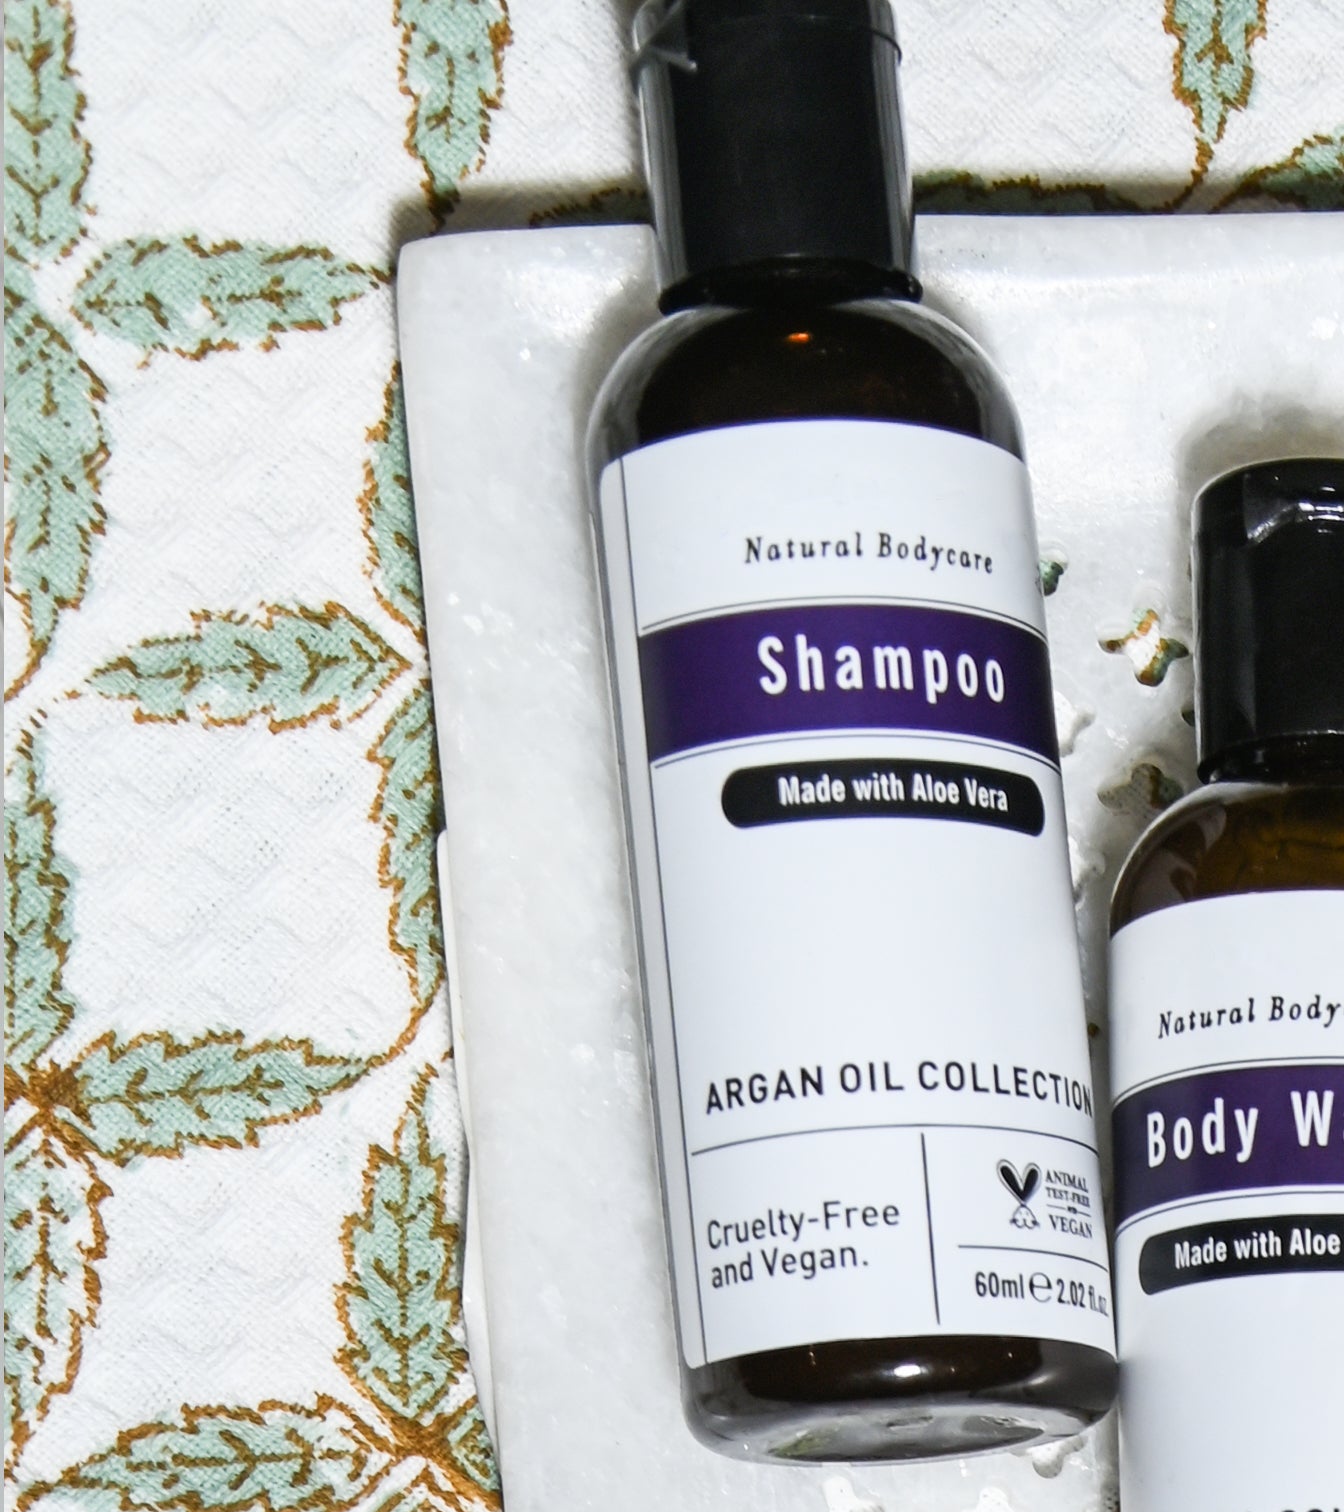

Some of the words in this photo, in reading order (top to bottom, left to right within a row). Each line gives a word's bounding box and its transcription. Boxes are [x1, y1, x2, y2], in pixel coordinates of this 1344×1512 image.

[745, 532, 862, 564] Natural
[877, 532, 993, 574] Bodycare
[757, 634, 1005, 704] Shampoo
[778, 775, 846, 806] Made
[852, 773, 904, 800] with
[911, 774, 960, 804] Aloe
[965, 779, 1009, 811] Vera
[1158, 998, 1256, 1039] Natural
[706, 1066, 825, 1115] ARGAN
[840, 1061, 905, 1093] OIL
[918, 1061, 1094, 1118] COLLECTION
[1146, 1097, 1259, 1168] Body
[1045, 1170, 1089, 1193] ANIMAL
[707, 1200, 900, 1250] Cruelty-Free
[1049, 1214, 1093, 1238] VEGAN
[711, 1252, 754, 1289] and
[761, 1244, 869, 1279] Vegan.
[1174, 1235, 1227, 1270] Made
[1234, 1230, 1282, 1260] with
[1289, 1228, 1341, 1257] Aloe
[975, 1271, 1025, 1299] 60ml
[1057, 1278, 1086, 1308] 2.02
